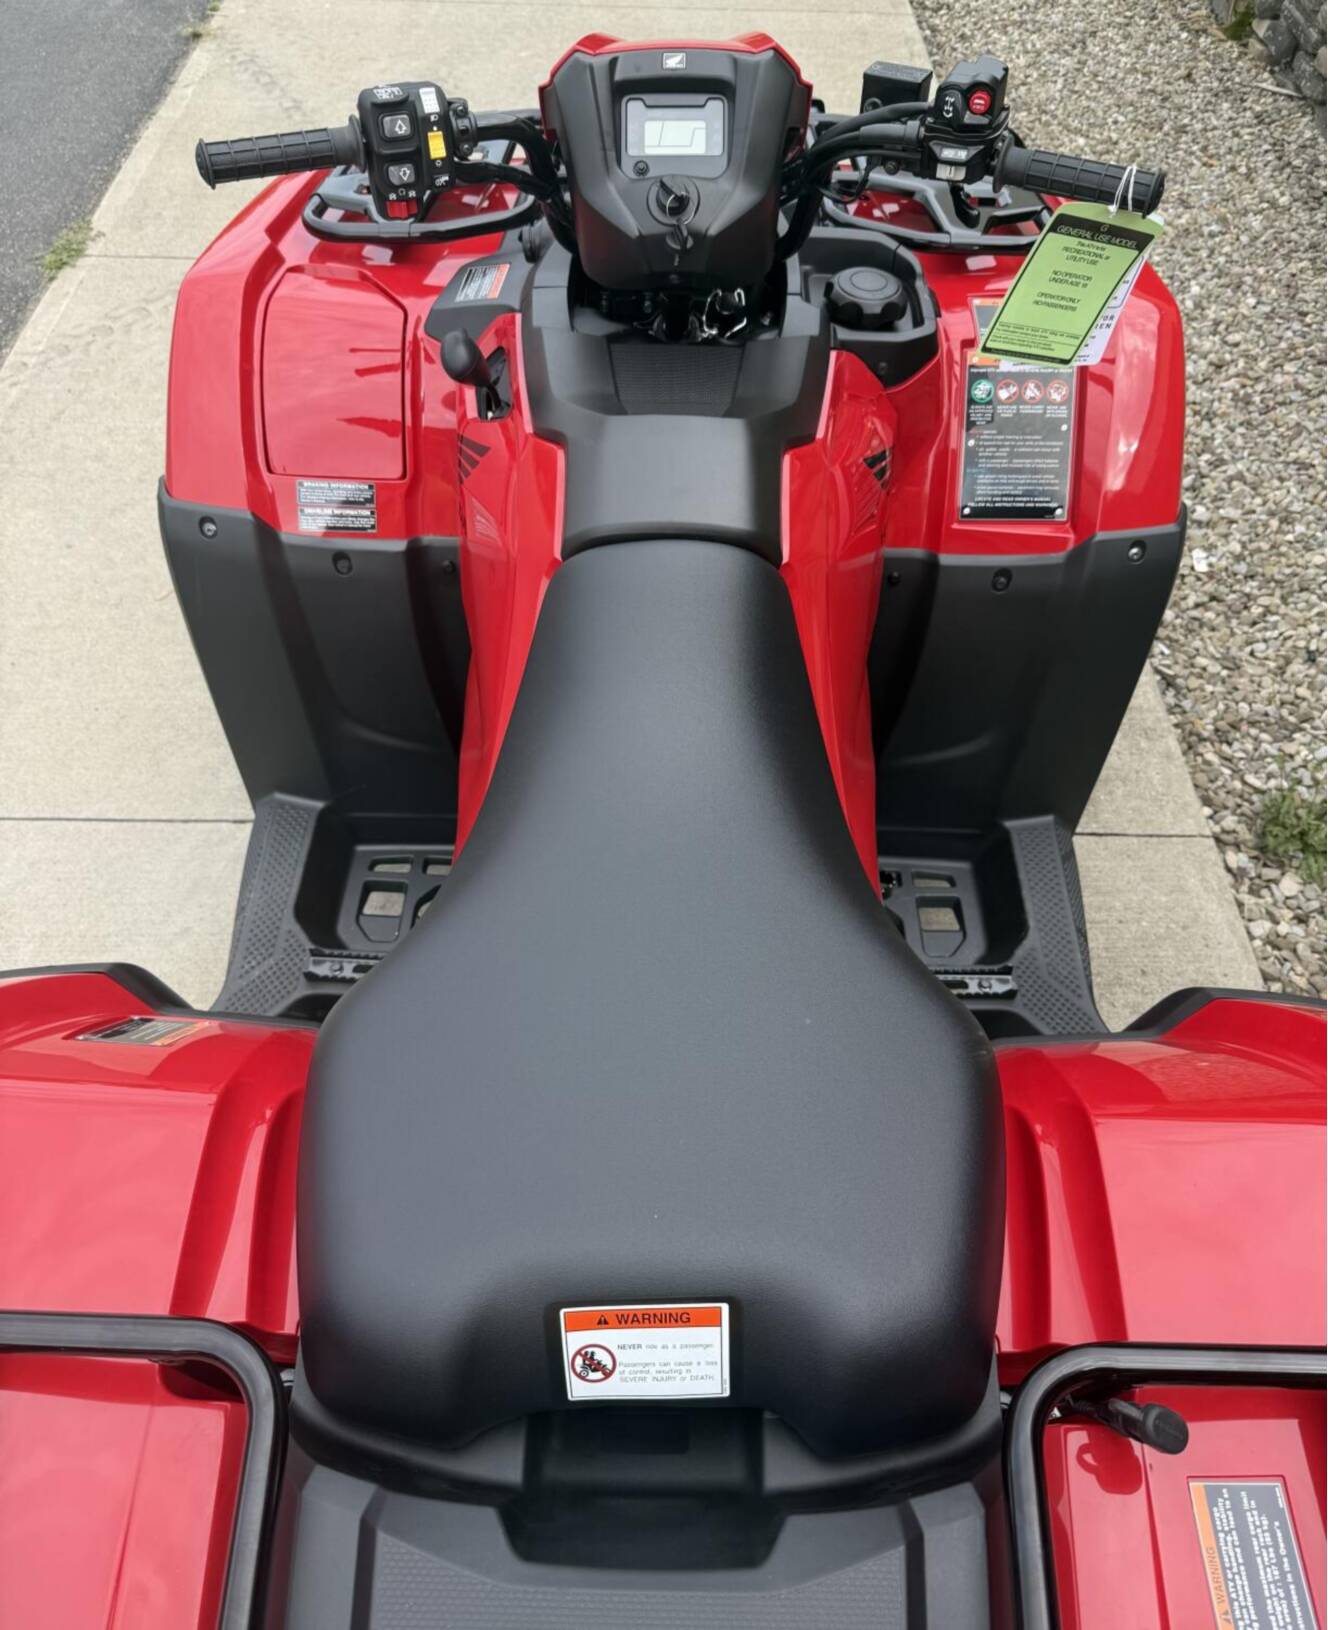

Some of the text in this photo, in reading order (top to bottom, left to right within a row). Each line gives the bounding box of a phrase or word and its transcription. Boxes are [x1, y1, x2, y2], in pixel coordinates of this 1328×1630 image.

[1100, 224, 1109, 232] G
[1056, 224, 1137, 248] GENERAL USE MODEL
[1048, 275, 1069, 285] UNDER
[1062, 270, 1092, 282] OPERATOR
[1063, 296, 1080, 304] ONLY
[615, 1311, 690, 1325] WARNING
[618, 1360, 655, 1369] Passengers
[1212, 1506, 1223, 1530] cargo
[1216, 1497, 1230, 1530] stability
[1205, 1546, 1226, 1604] WARNING
